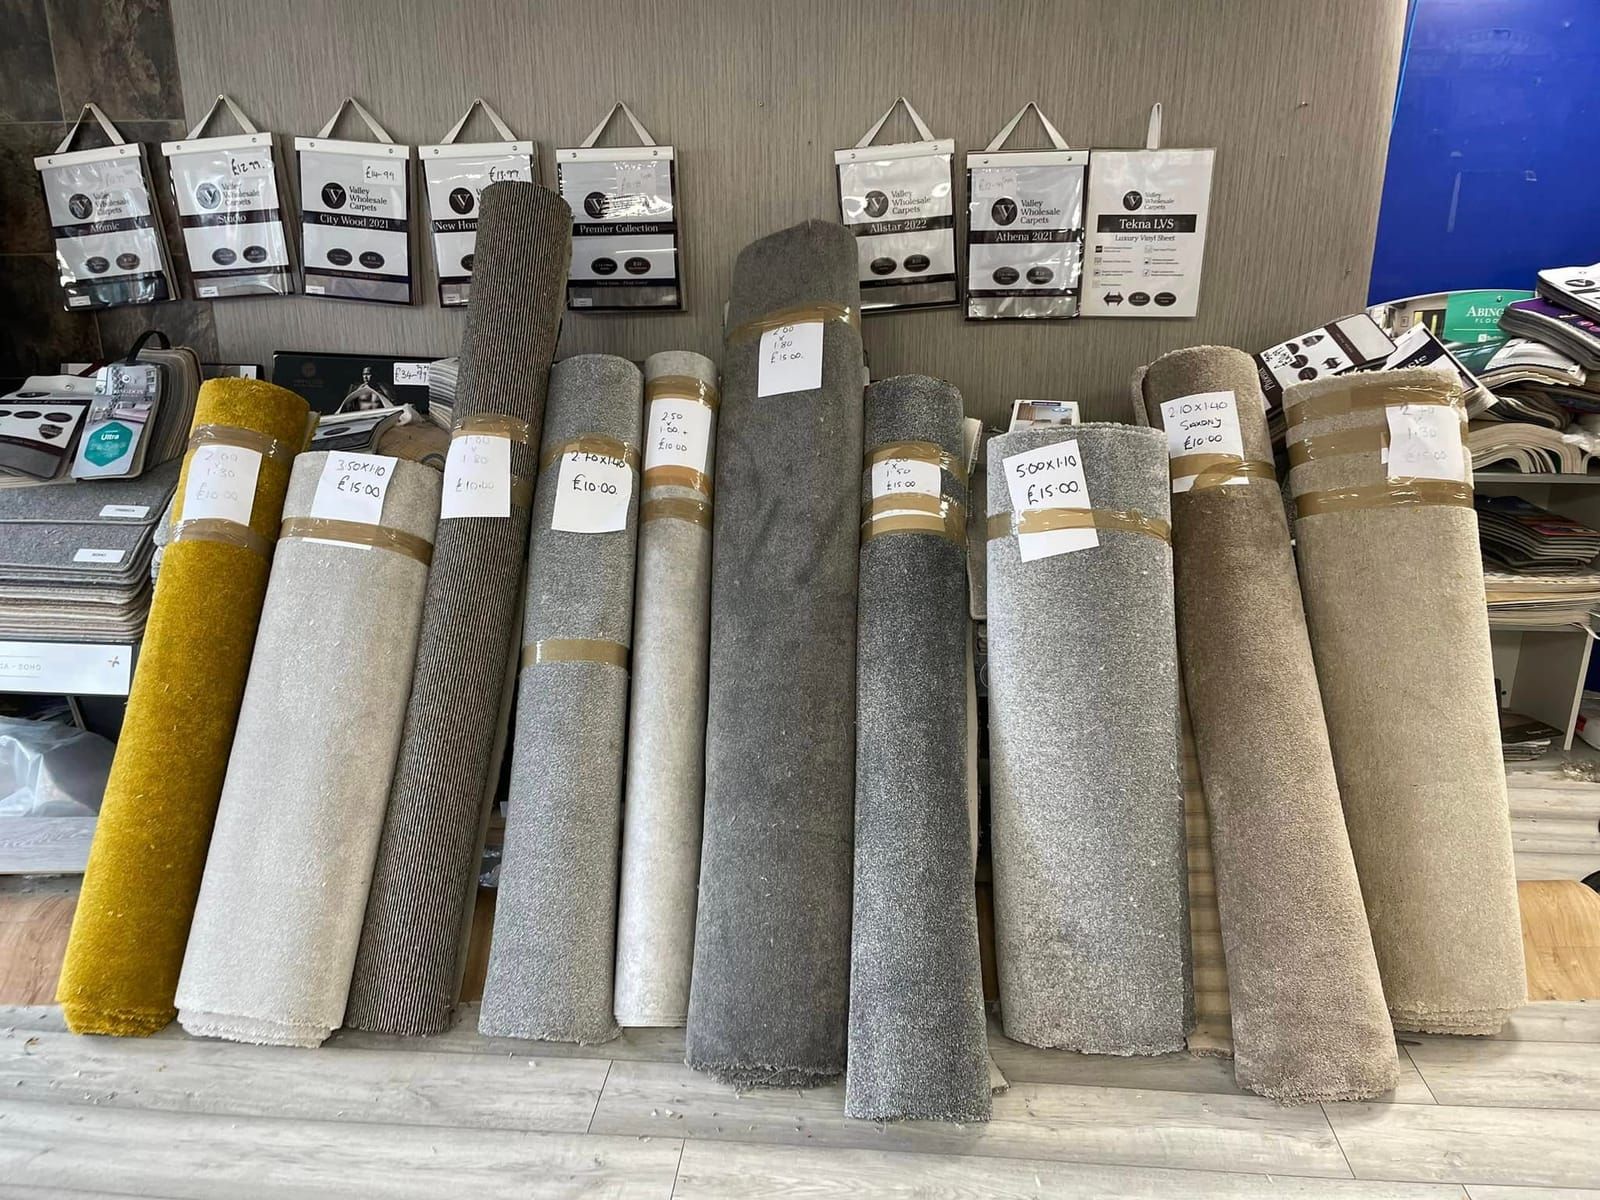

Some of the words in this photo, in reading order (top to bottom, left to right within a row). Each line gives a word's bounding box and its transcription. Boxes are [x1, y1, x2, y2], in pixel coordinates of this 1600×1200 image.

[349, 185, 370, 195] Valley
[891, 190, 913, 199] Valley
[349, 194, 388, 205] Wholesale
[892, 196, 932, 206] Wholesale
[1020, 199, 1043, 208] Valley
[349, 203, 377, 212] Carpets
[892, 206, 921, 215] Carpets
[1020, 207, 1061, 216] Wholesale
[217, 214, 247, 225] Studio
[320, 213, 339, 226] City
[341, 215, 367, 227] Wood
[369, 218, 389, 229] 2021
[1020, 216, 1049, 226] Carpets
[1119, 218, 1151, 230] Tekna
[1153, 218, 1175, 229] LVS
[435, 221, 456, 231] New
[580, 224, 614, 233] Premier
[615, 224, 659, 233] Collection
[870, 223, 901, 233] Allstar
[904, 219, 928, 230] 2022
[995, 231, 1030, 243] Athena
[1032, 231, 1053, 241] 2021
[1115, 234, 1138, 243] Luxury
[1140, 234, 1157, 242] Vinyl
[1157, 234, 1176, 242] Sheet
